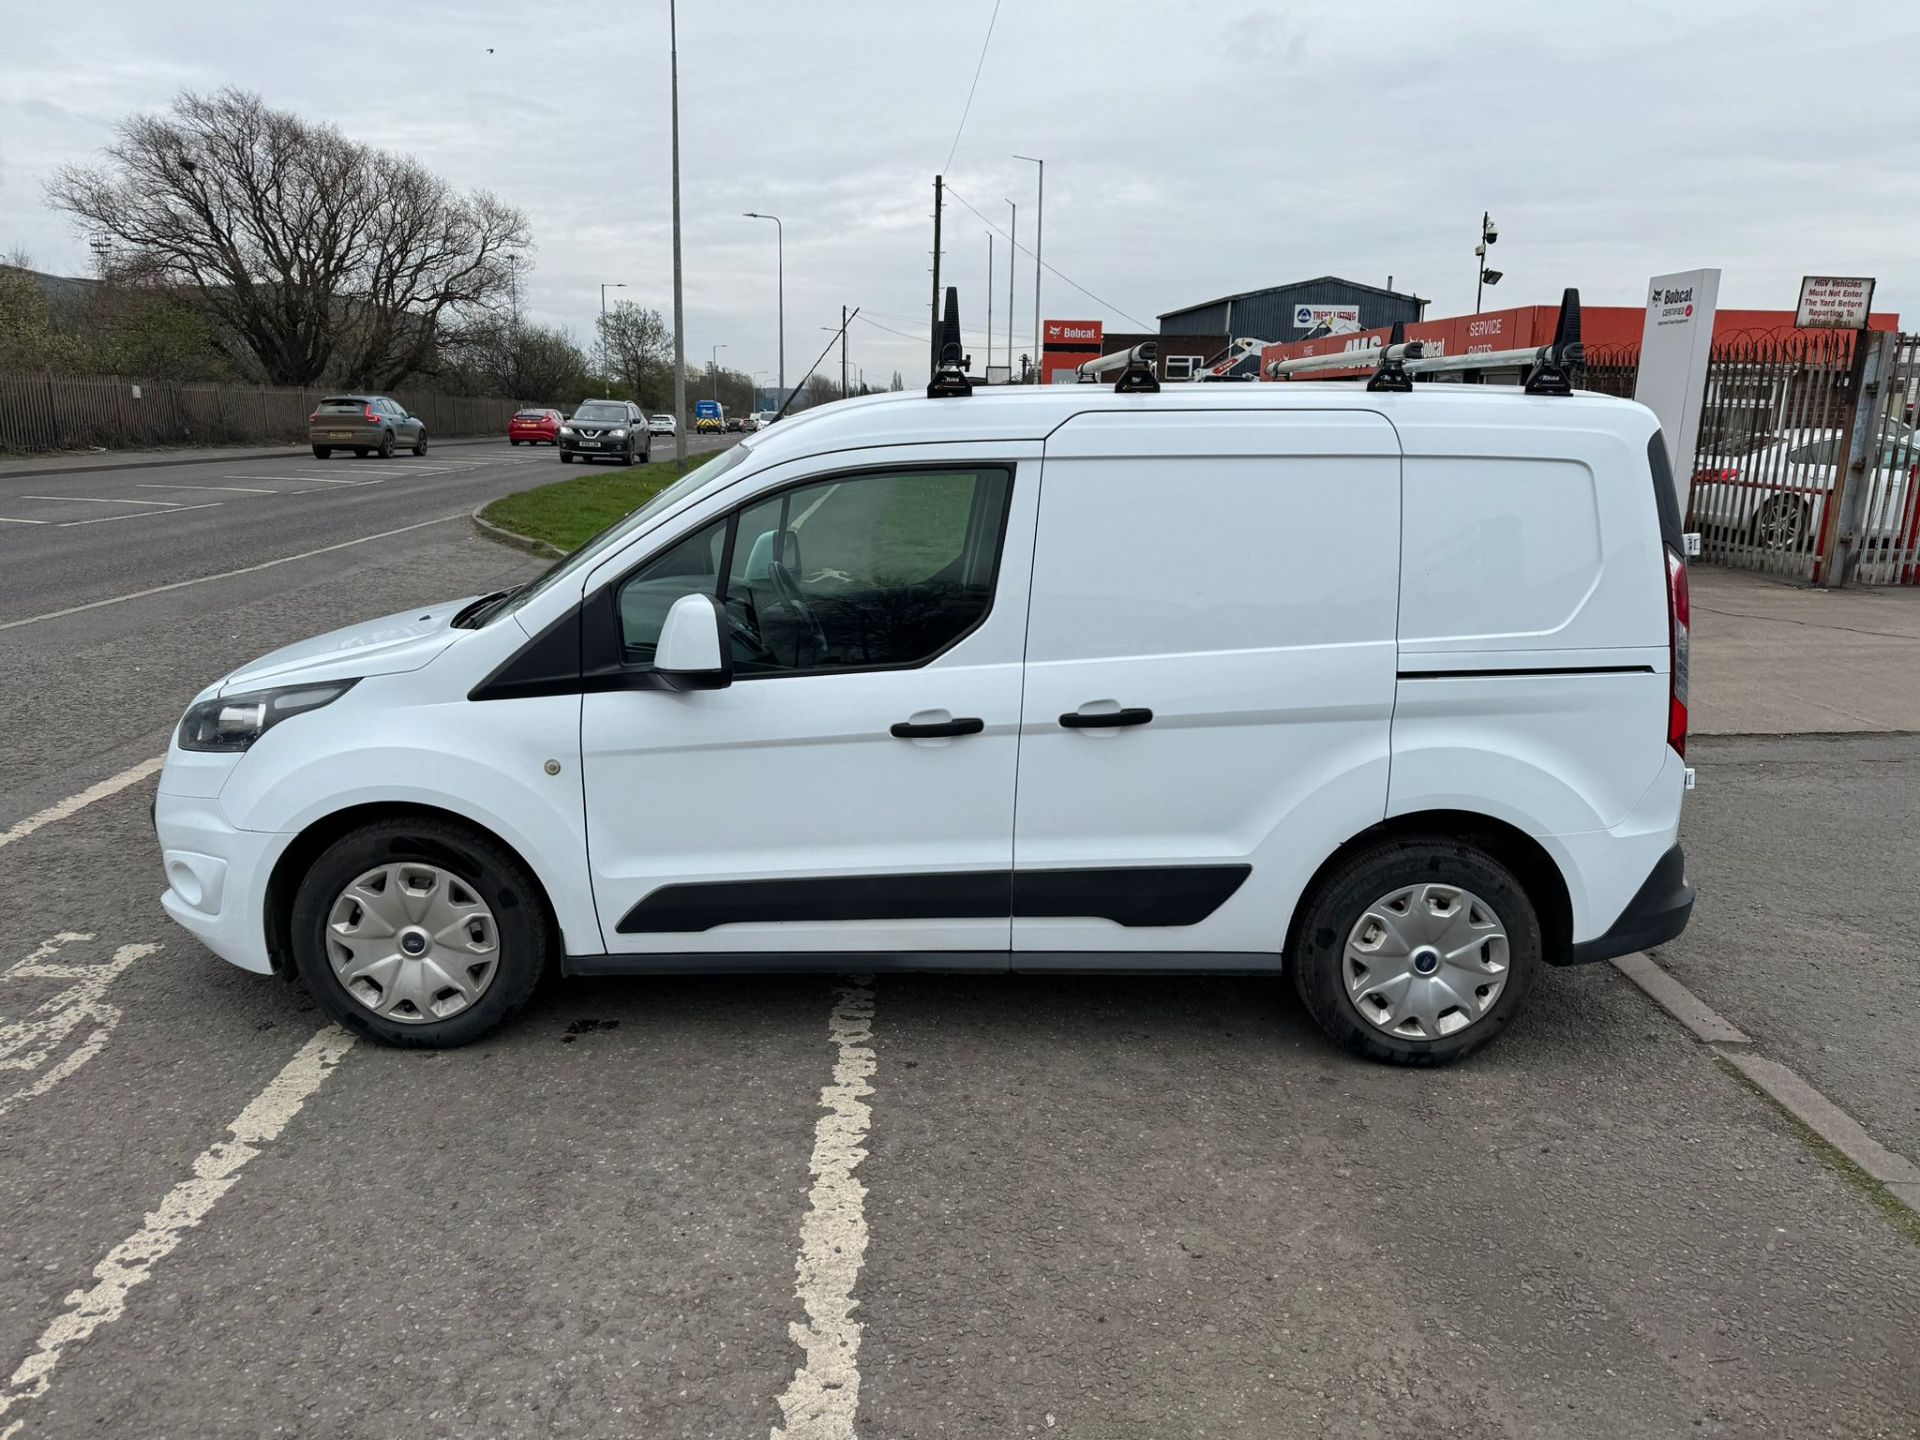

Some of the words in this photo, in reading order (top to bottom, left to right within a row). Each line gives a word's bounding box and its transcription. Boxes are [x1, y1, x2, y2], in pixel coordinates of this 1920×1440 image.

[1814, 279, 1830, 287] HGV
[1832, 279, 1863, 288] Vehicles
[1664, 287, 1693, 305] Bobcat
[1808, 289, 1827, 297] Must
[1828, 289, 1841, 297] Not
[1843, 290, 1863, 298] Enter
[1804, 298, 1817, 306] The
[1820, 299, 1836, 307] Yard
[1838, 300, 1863, 308] Before
[1808, 308, 1844, 318] Reporting
[1846, 309, 1855, 317] To
[1470, 319, 1502, 336] SERVICE
[1064, 328, 1096, 338] Bobcat
